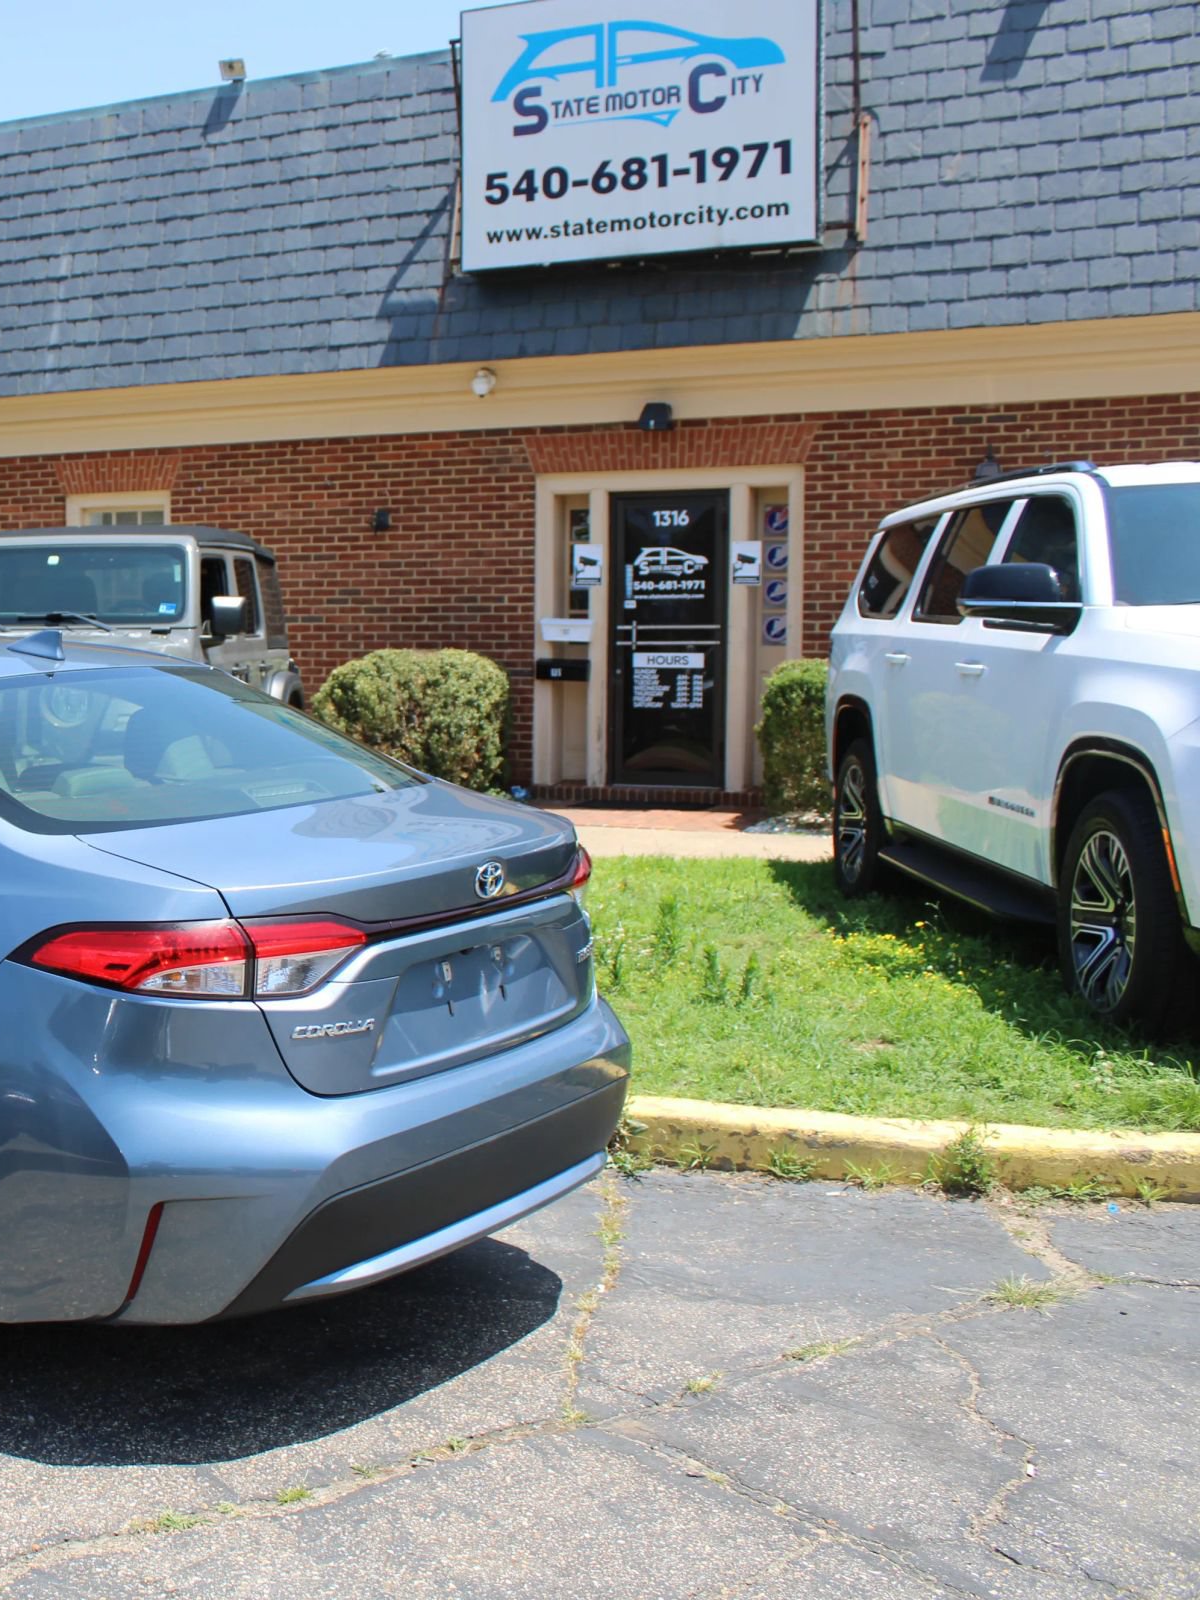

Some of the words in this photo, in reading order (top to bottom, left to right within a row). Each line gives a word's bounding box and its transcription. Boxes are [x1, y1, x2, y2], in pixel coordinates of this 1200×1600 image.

[513, 86, 600, 137] STATE
[604, 85, 681, 113] MOTOR
[688, 62, 764, 114] CITY
[484, 139, 793, 206] 540-681-1971
[487, 201, 790, 244] www.statemotorcity.com
[652, 509, 690, 527] 1316
[647, 655, 689, 665] HOURS
[291, 1018, 375, 1040] COROLLA
